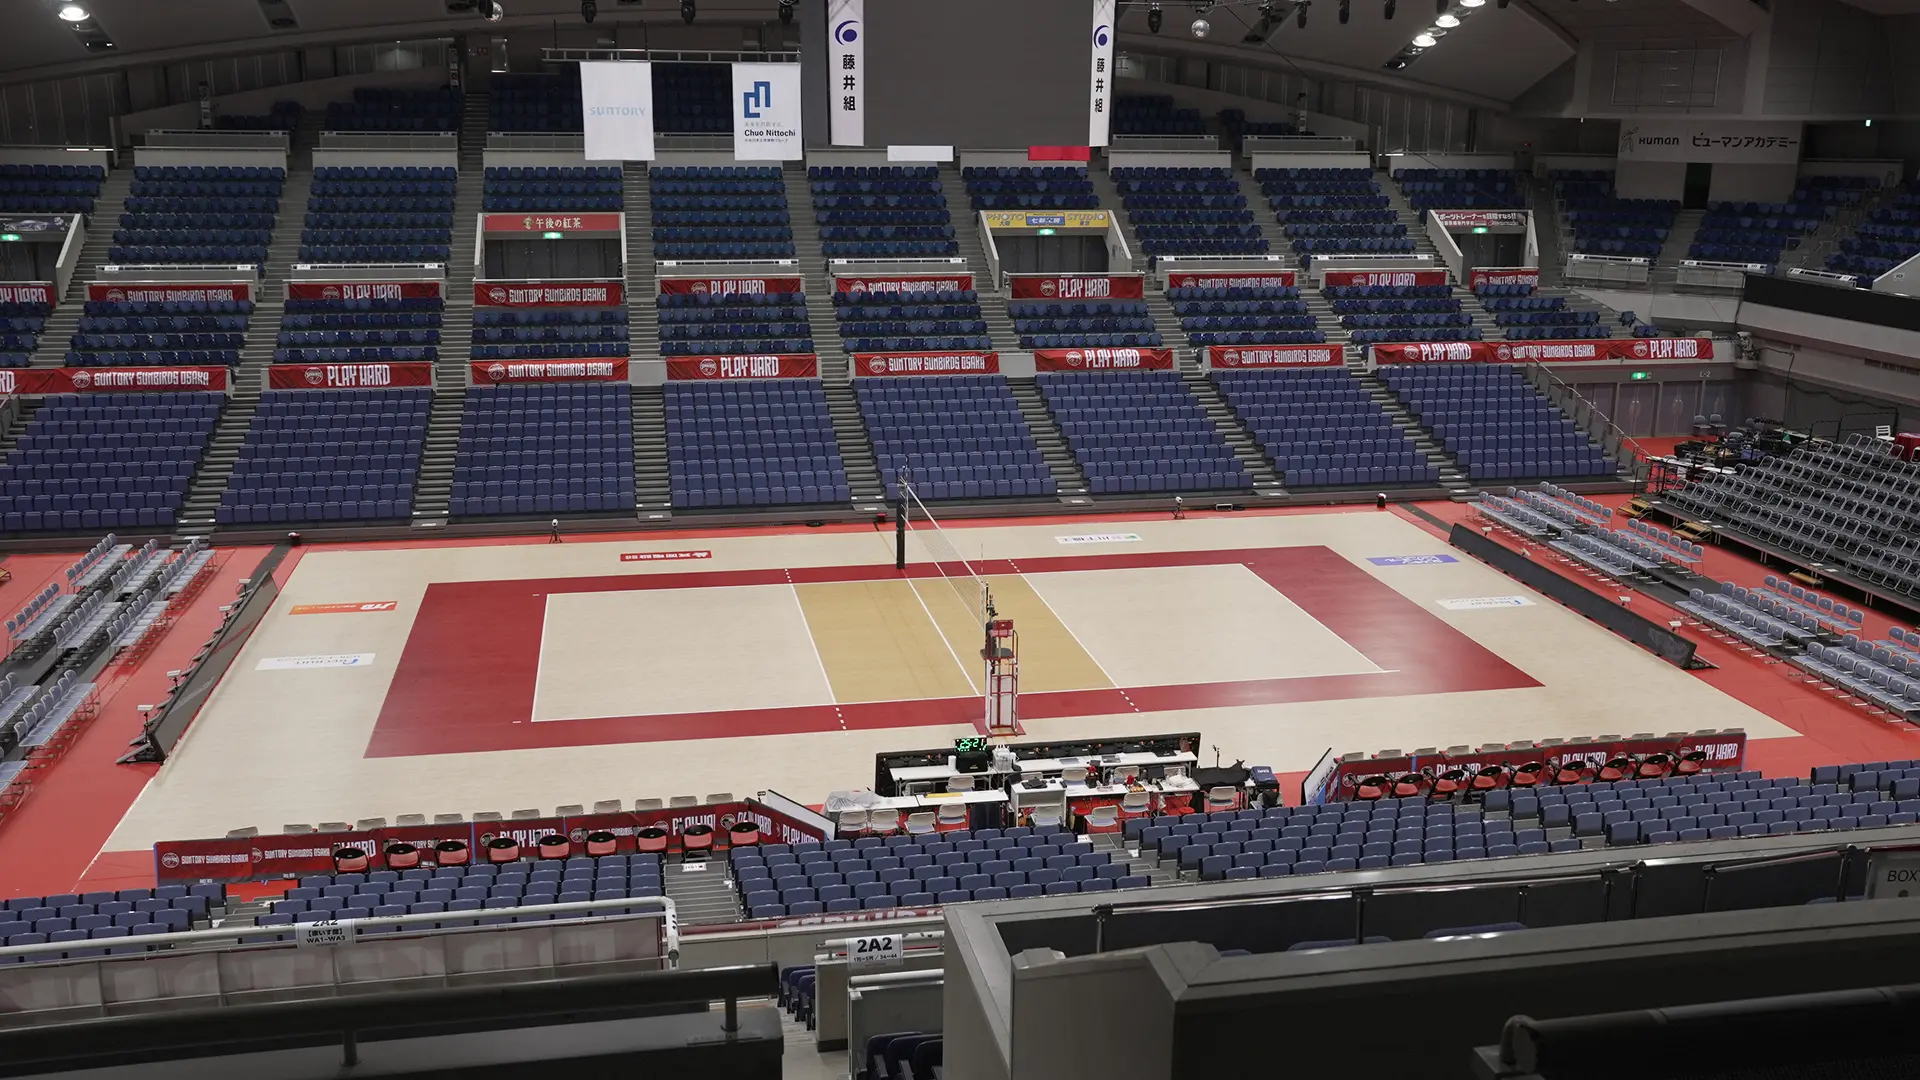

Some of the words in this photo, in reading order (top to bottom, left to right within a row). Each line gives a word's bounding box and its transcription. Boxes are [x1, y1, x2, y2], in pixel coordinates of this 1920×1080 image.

[842, 54, 856, 111] 藤井組
[1095, 57, 1105, 113] 藤井組
[589, 106, 646, 116] SUNTORY
[744, 129, 764, 137] Chuo
[766, 129, 796, 137] Nittochi
[535, 217, 581, 229] 午後の紅茶
[1066, 213, 1107, 221] STUDIO
[509, 289, 543, 303] SUNTORY
[545, 288, 581, 302] SUNBIRDS
[582, 288, 607, 302] OSAKA
[1059, 279, 1083, 298] PLAY
[1085, 279, 1110, 297] HARD
[1241, 350, 1272, 363] SUNTORY
[1273, 349, 1307, 362] SUNBIRDS
[1308, 349, 1330, 362] OSAKA
[1421, 343, 1445, 361] PLAY
[1446, 343, 1471, 360] HARD
[1512, 346, 1542, 359] SUNTORY
[1543, 345, 1573, 357] SUNBIRDS
[1574, 344, 1595, 357] OSAKA
[1649, 339, 1672, 359] PLAY
[1673, 339, 1698, 358] HARD
[889, 356, 922, 370] SUNTORY
[923, 356, 960, 369] SUNBIRDS
[961, 355, 985, 369] OSAKA
[1085, 349, 1111, 368] PLAY
[1112, 349, 1140, 367] HARD
[508, 364, 545, 377] SUNTORY
[546, 363, 586, 376] SUNBIRDS
[587, 362, 613, 375] OSAKA
[720, 356, 749, 377] PLAY
[750, 356, 779, 376] HARD
[94, 372, 135, 386] SUNTORY
[136, 372, 179, 385] SUNBIRDS
[180, 371, 209, 385] OSAKA
[327, 366, 357, 387] PLAY
[359, 365, 390, 385] HARD
[1715, 743, 1738, 760] HARD
[181, 855, 205, 865] SUNTORY
[206, 854, 231, 864] SUNBIRDS
[231, 853, 249, 864] OSAKA
[264, 849, 287, 860] SUNTORY
[288, 849, 313, 859] SUNBIRDS
[313, 847, 331, 857] OSAKA
[1886, 869, 1920, 883] BOX
[857, 937, 893, 953] 2A2
